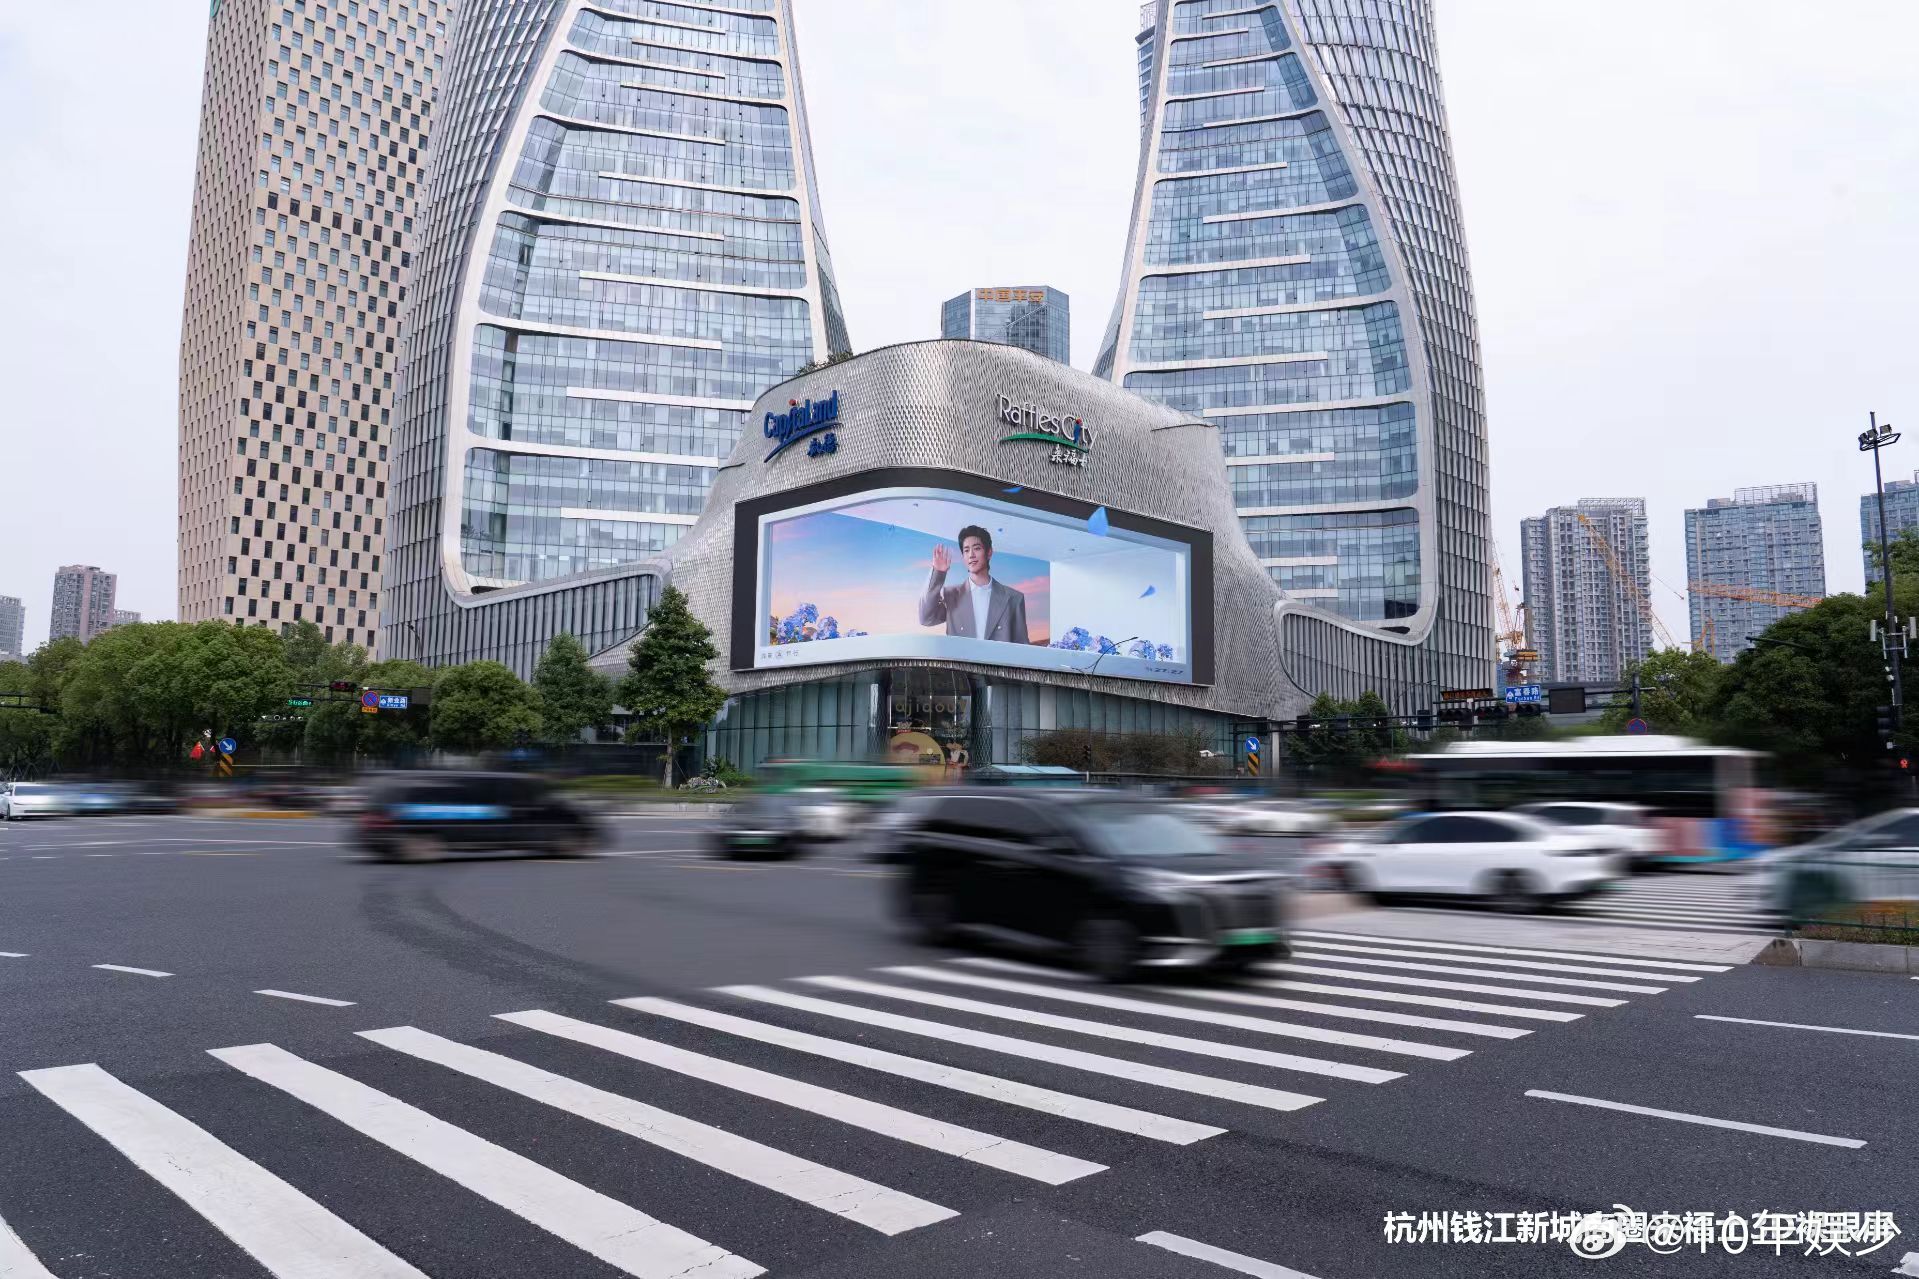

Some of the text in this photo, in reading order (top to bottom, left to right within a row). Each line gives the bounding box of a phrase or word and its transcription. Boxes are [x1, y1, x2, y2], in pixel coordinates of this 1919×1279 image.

[764, 390, 838, 444] CapitaLand
[997, 394, 1098, 450] Raffles City
[1050, 444, 1088, 467] 来福士
